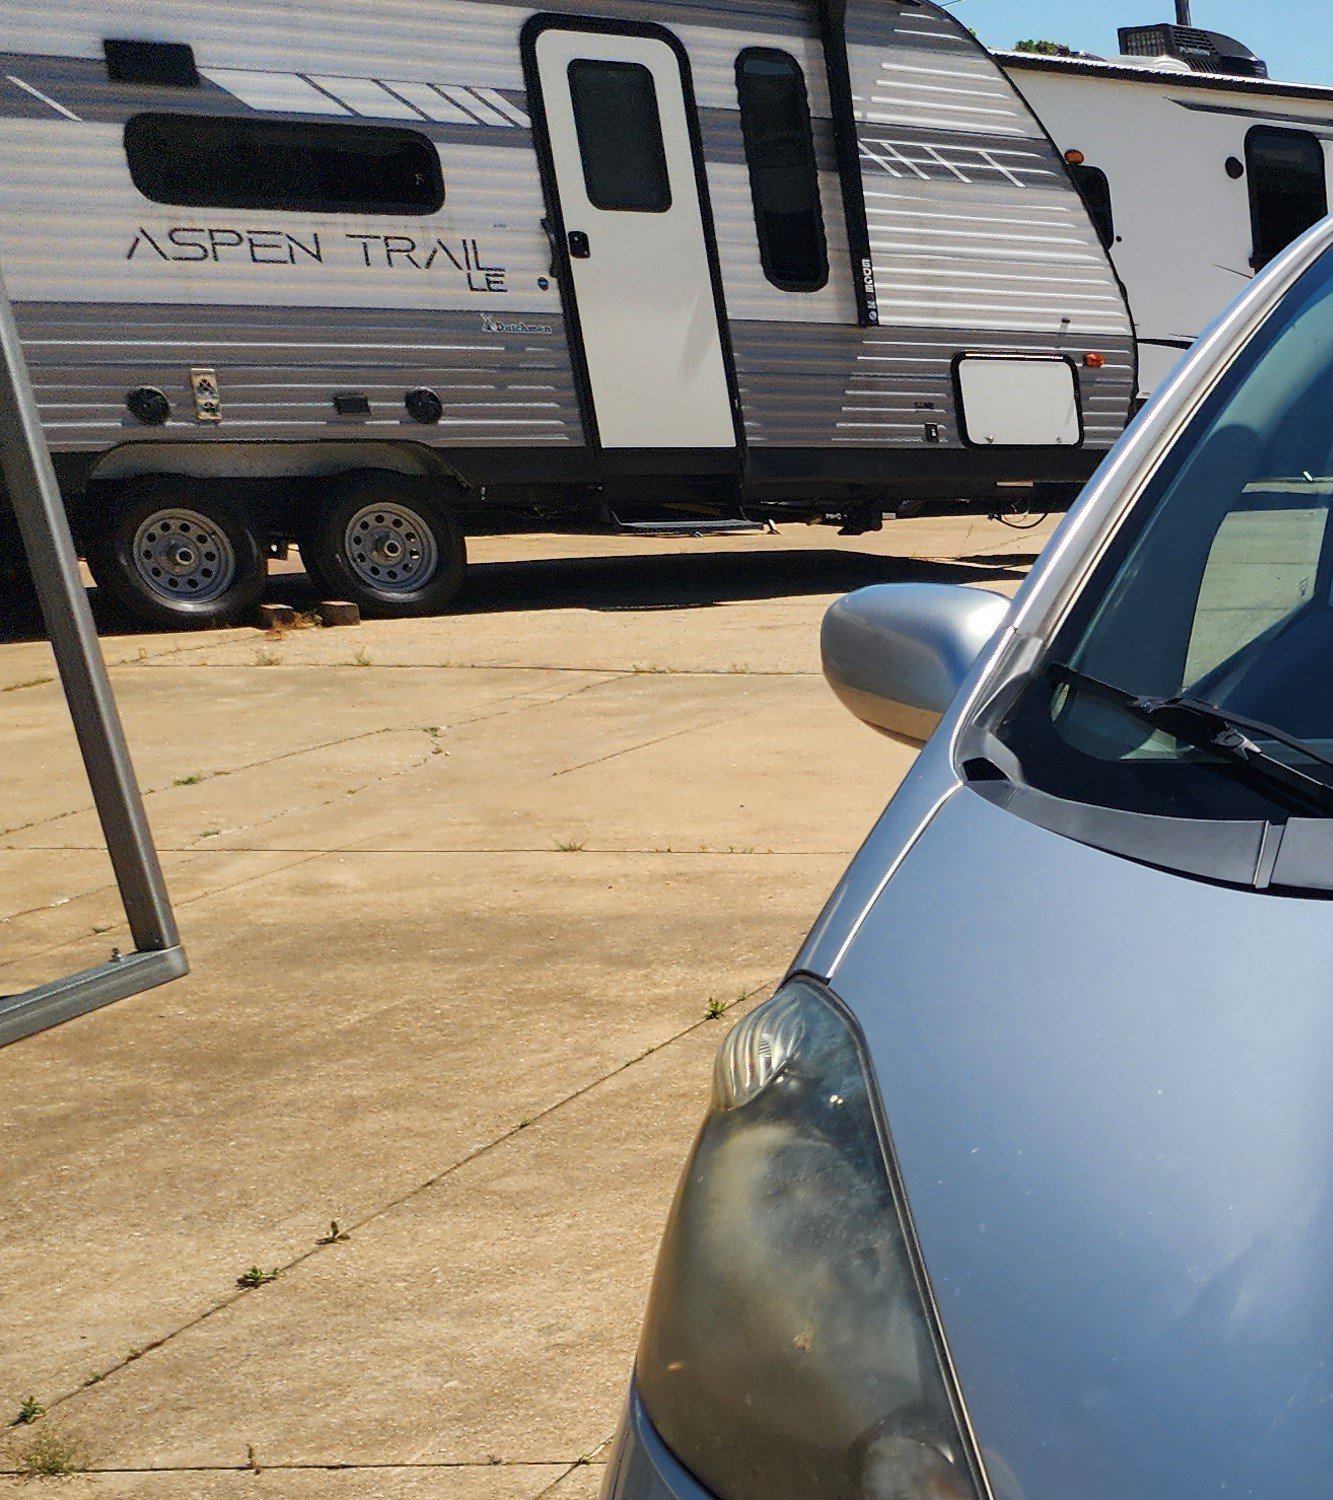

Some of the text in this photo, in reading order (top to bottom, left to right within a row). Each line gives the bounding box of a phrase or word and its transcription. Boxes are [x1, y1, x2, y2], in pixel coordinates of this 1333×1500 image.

[126, 226, 506, 272] ASPEN TRAIL
[466, 272, 508, 293] LE
[861, 258, 875, 293] EDGE
